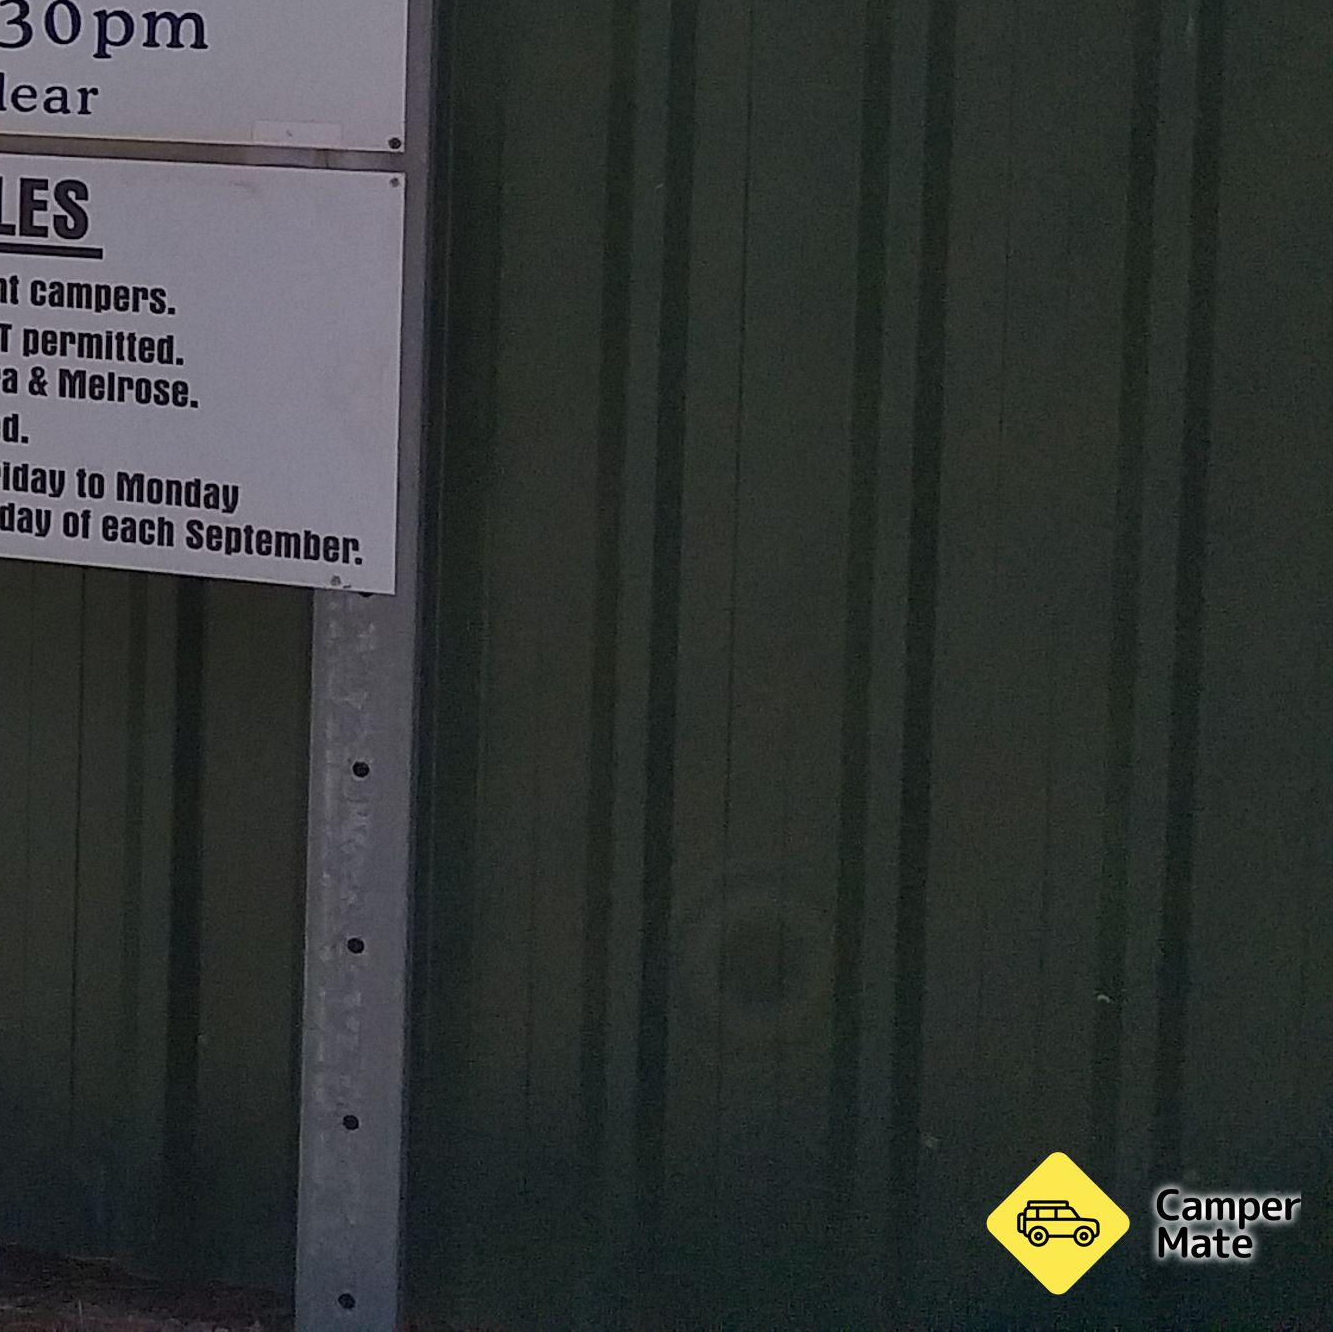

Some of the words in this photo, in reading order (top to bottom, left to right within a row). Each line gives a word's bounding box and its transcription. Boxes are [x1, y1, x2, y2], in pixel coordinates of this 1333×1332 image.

[31, 280, 175, 314] campers.
[23, 329, 183, 365] permitted.
[29, 367, 48, 396] &
[59, 369, 198, 408] Melrose.
[76, 469, 104, 498] to
[117, 472, 238, 513] Monday
[63, 510, 91, 539] of
[102, 516, 173, 547] each
[186, 520, 362, 565] September.
